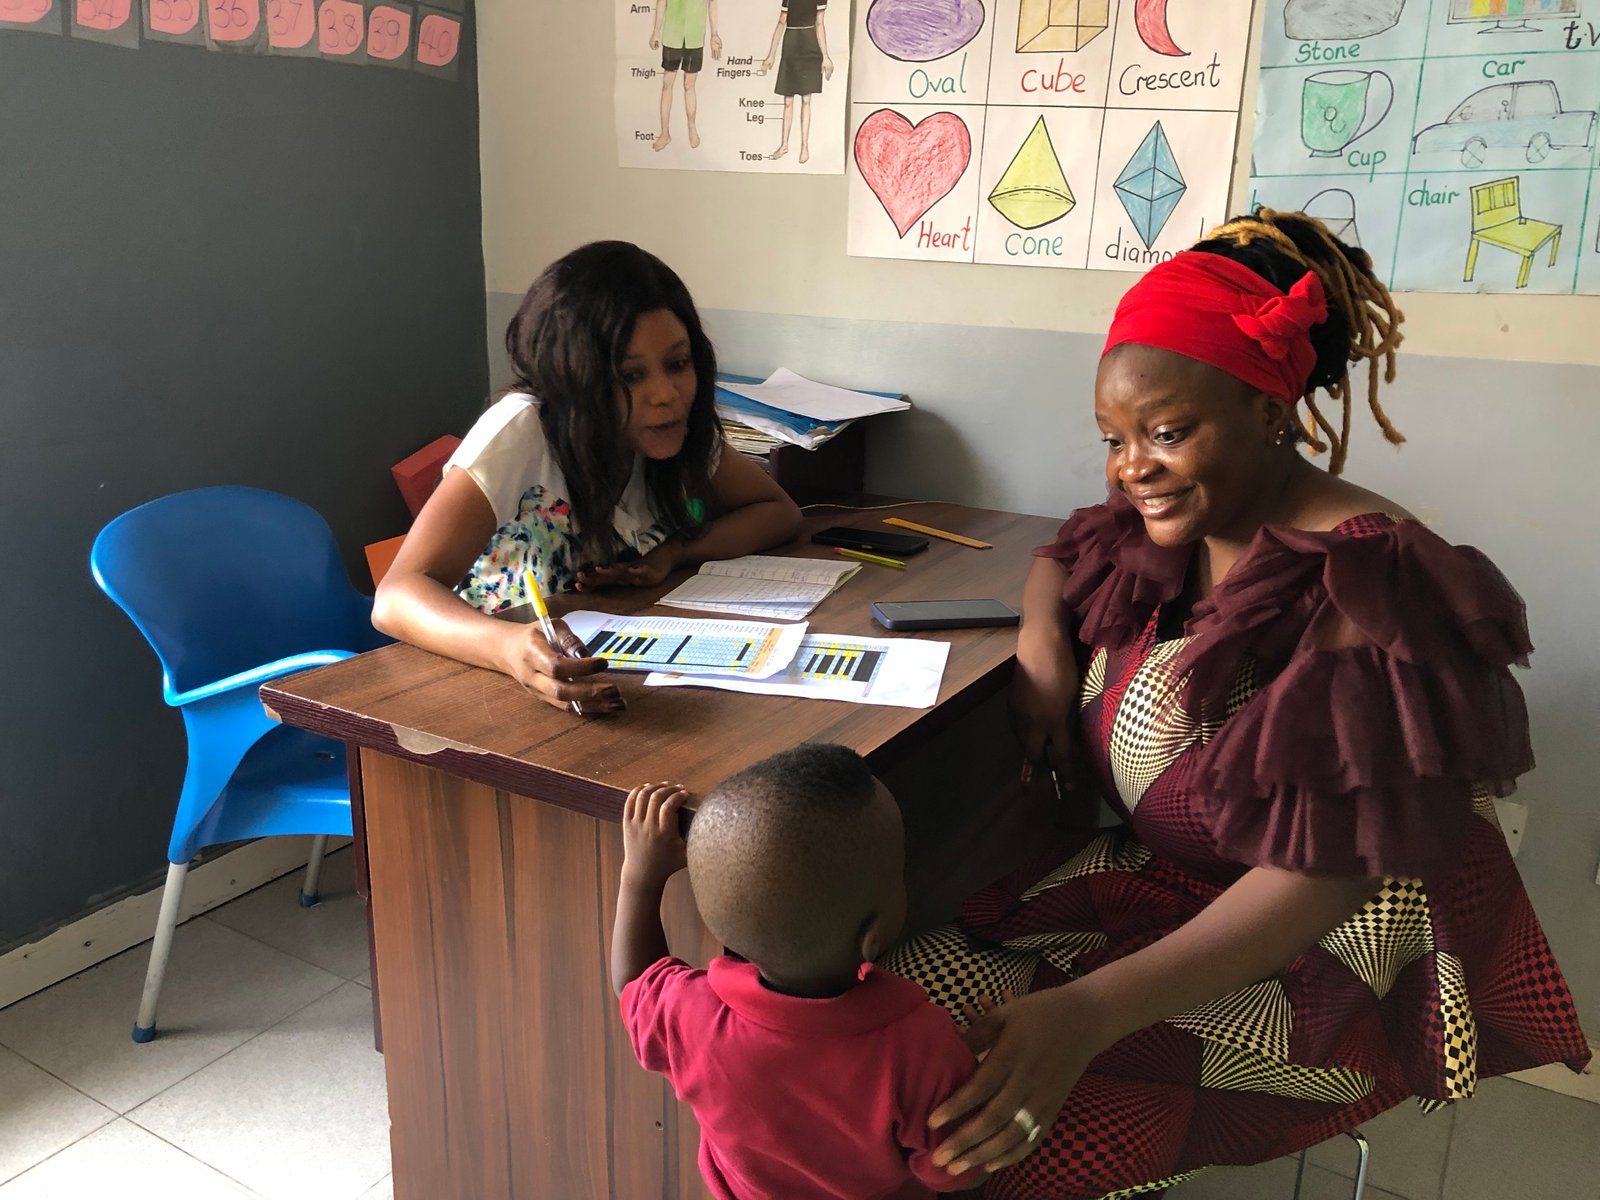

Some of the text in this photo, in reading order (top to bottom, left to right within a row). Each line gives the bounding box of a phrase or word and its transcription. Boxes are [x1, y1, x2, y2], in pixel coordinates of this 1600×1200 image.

[214, 0, 249, 28] 36
[271, 0, 303, 35] 37
[630, 4, 651, 14] Arm
[324, 9, 359, 48] 38
[371, 16, 400, 53] 39
[421, 25, 450, 58] 40
[726, 55, 753, 66] Hand
[631, 67, 656, 79] Thigh
[717, 67, 751, 79] Fingers
[908, 52, 967, 98] Oval
[1118, 52, 1222, 96] Crescent
[738, 98, 765, 108] Knee
[746, 112, 765, 124] Leg
[635, 131, 655, 141] Foot
[739, 151, 763, 161] Toes
[917, 216, 971, 252] Heart
